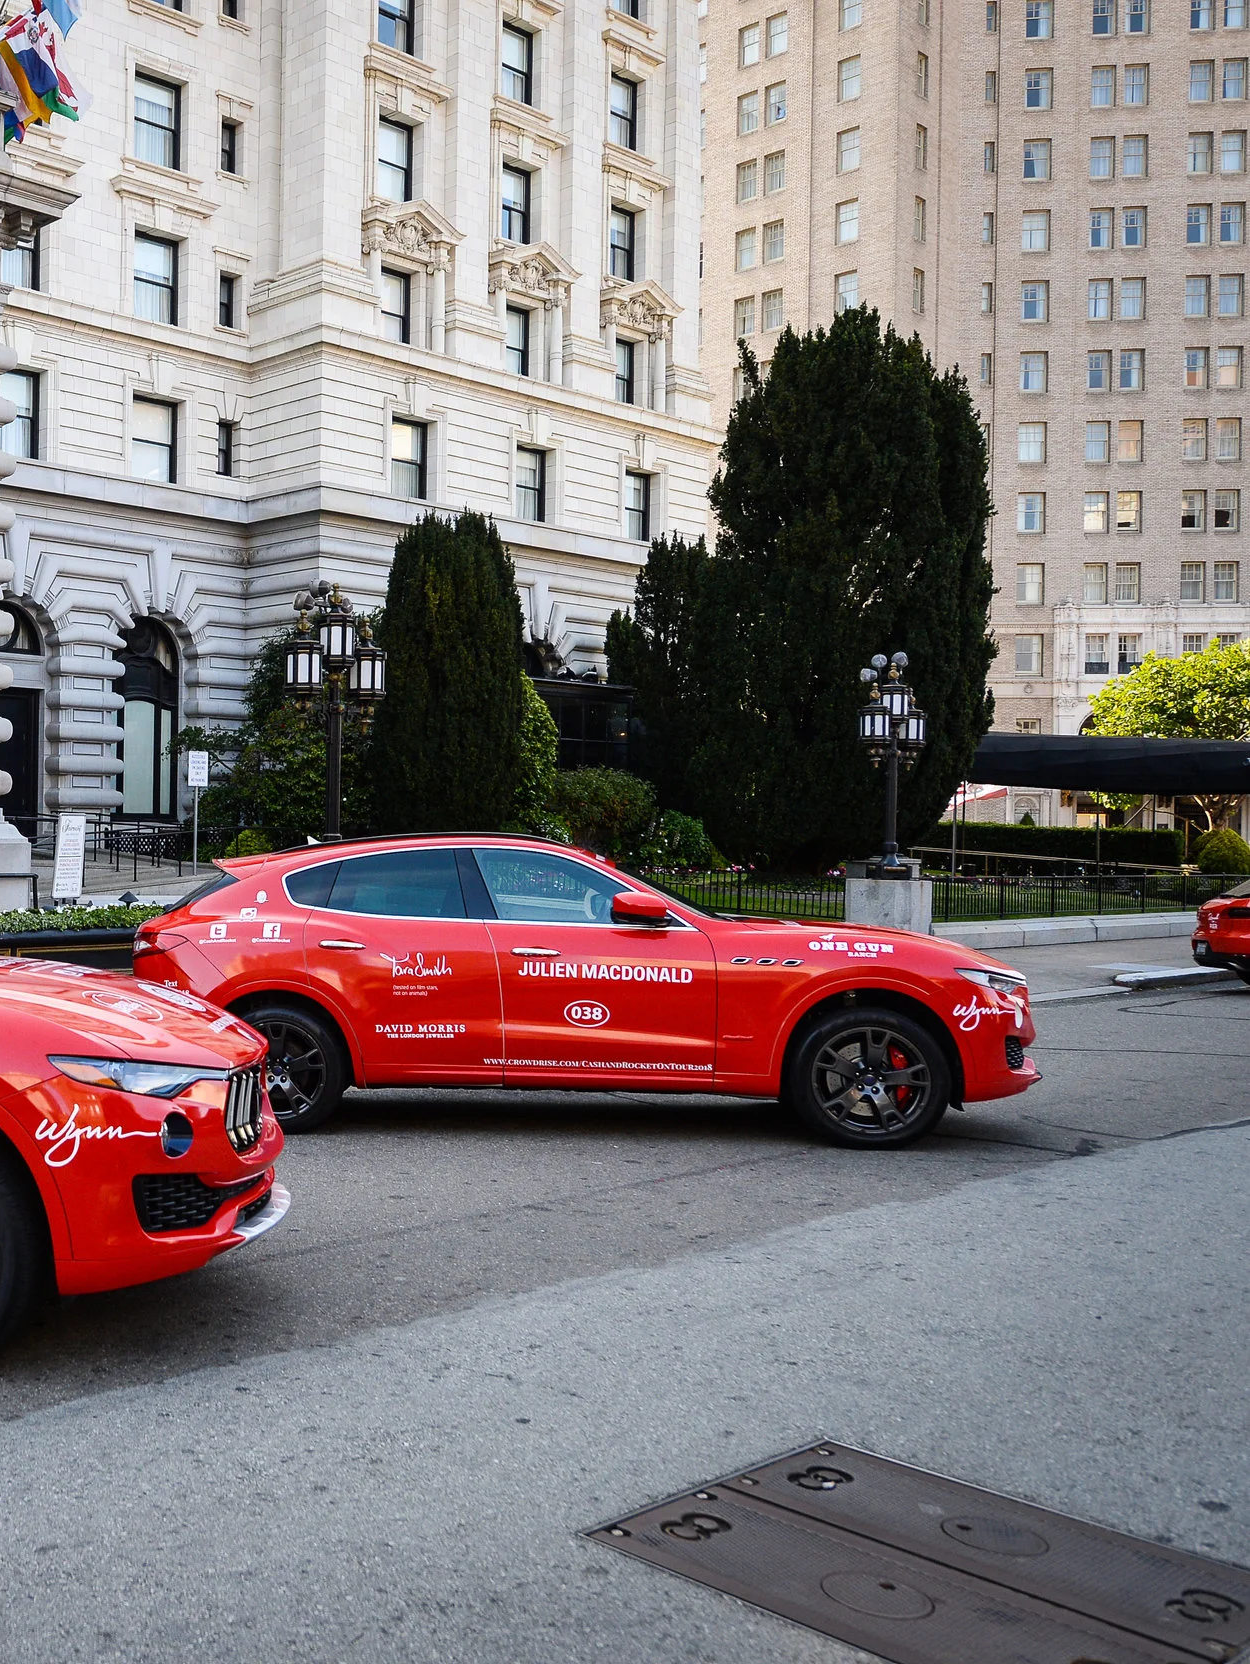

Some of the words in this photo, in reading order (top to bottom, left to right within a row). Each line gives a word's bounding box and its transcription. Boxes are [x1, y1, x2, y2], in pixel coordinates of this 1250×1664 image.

[808, 941, 848, 951] ONE
[853, 942, 894, 954] GUN
[379, 952, 414, 978] Tara
[414, 952, 453, 978] Smith
[518, 961, 578, 978] JULIEN
[581, 963, 693, 984] MACDONALD
[163, 979, 178, 988] Text
[571, 1006, 603, 1021] 038
[953, 995, 1015, 1031] Wynn
[375, 1024, 413, 1033] DAVID
[418, 1024, 466, 1033] MORRIS
[35, 1103, 157, 1168] Wynn
